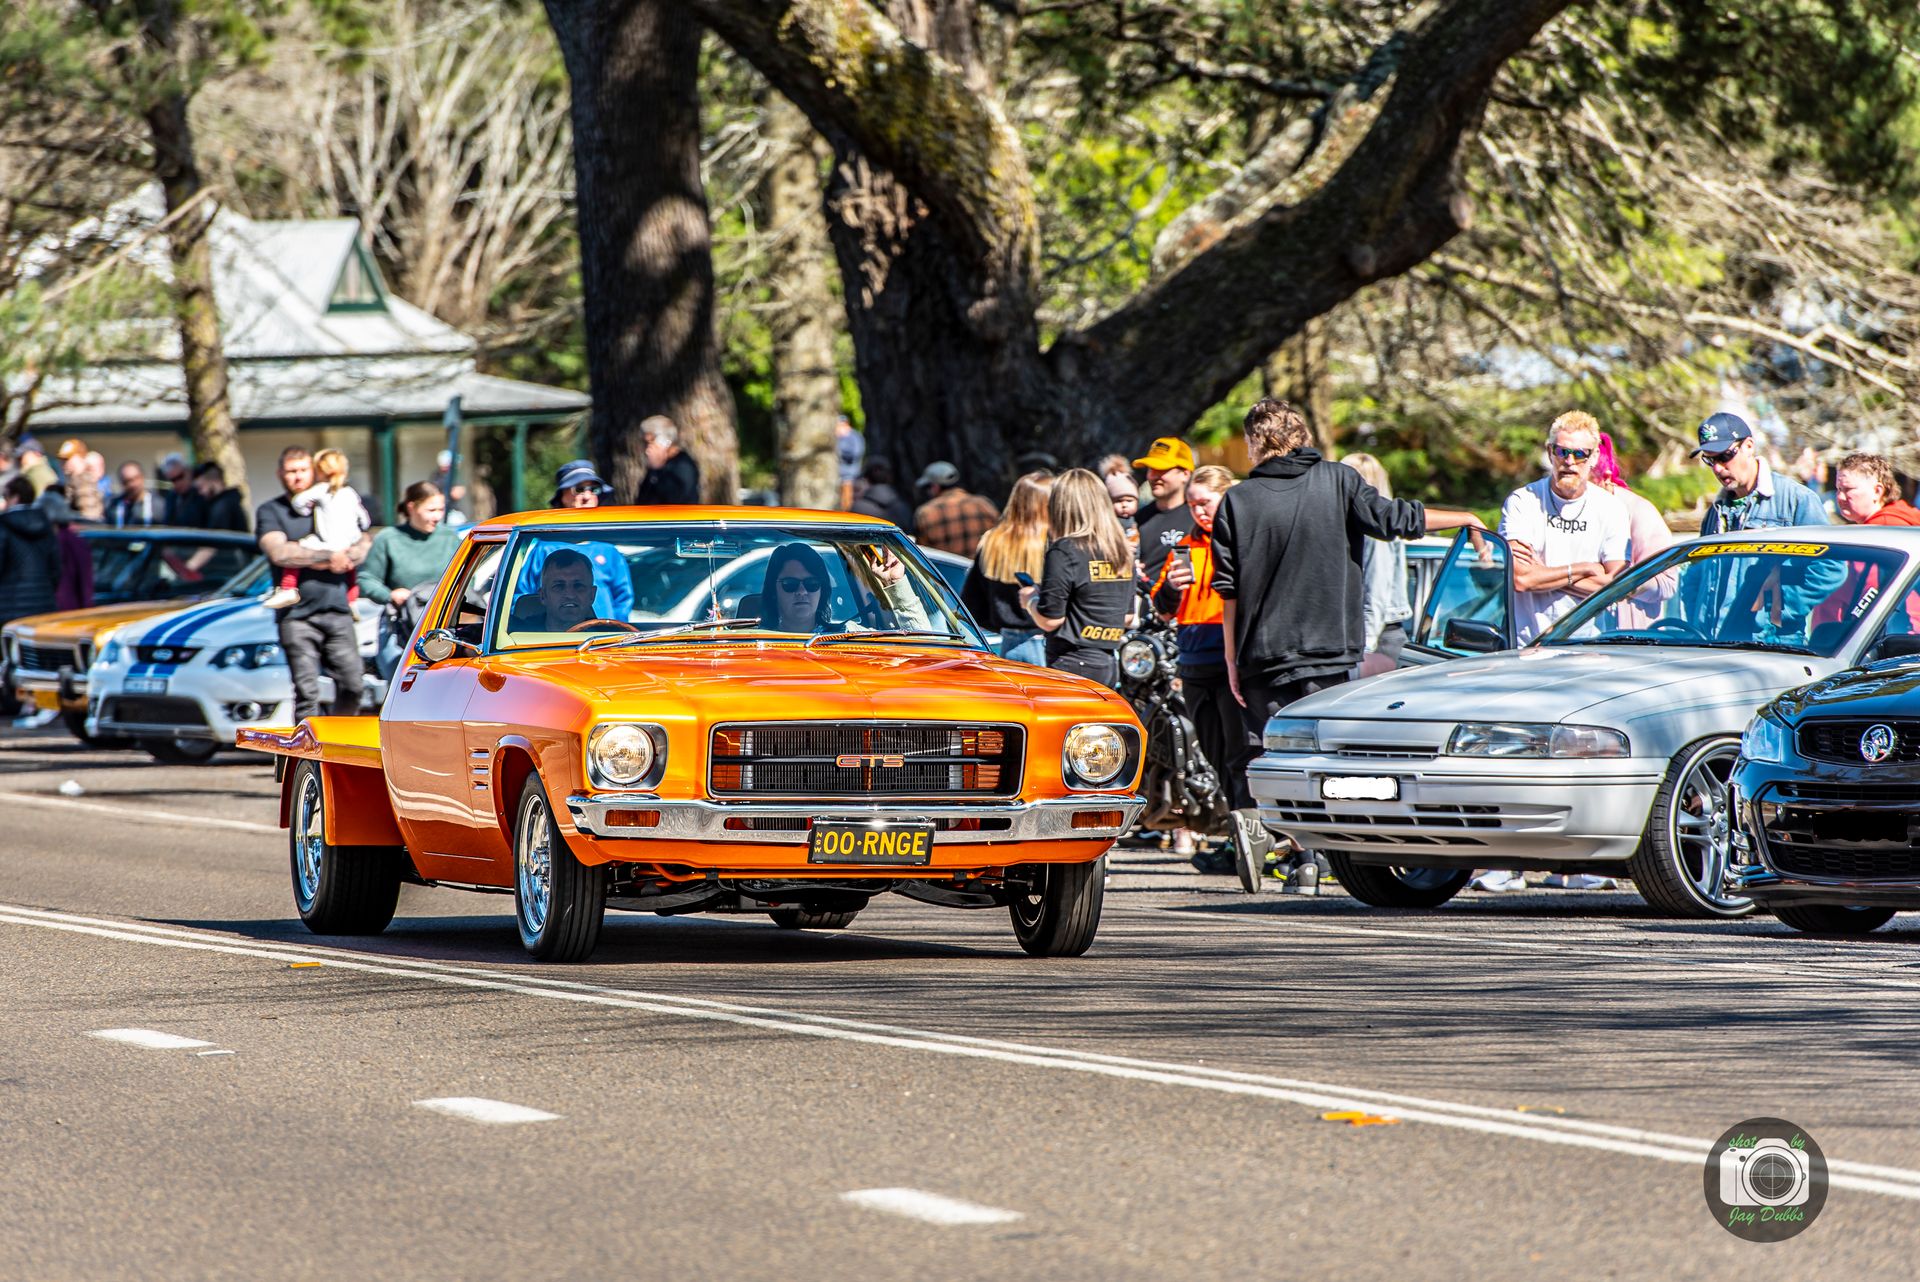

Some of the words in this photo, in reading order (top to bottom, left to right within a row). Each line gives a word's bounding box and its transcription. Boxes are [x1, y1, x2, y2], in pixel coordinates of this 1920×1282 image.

[1546, 514, 1587, 534] Kappa
[1081, 625, 1104, 640] OG
[836, 754, 905, 768] GTS
